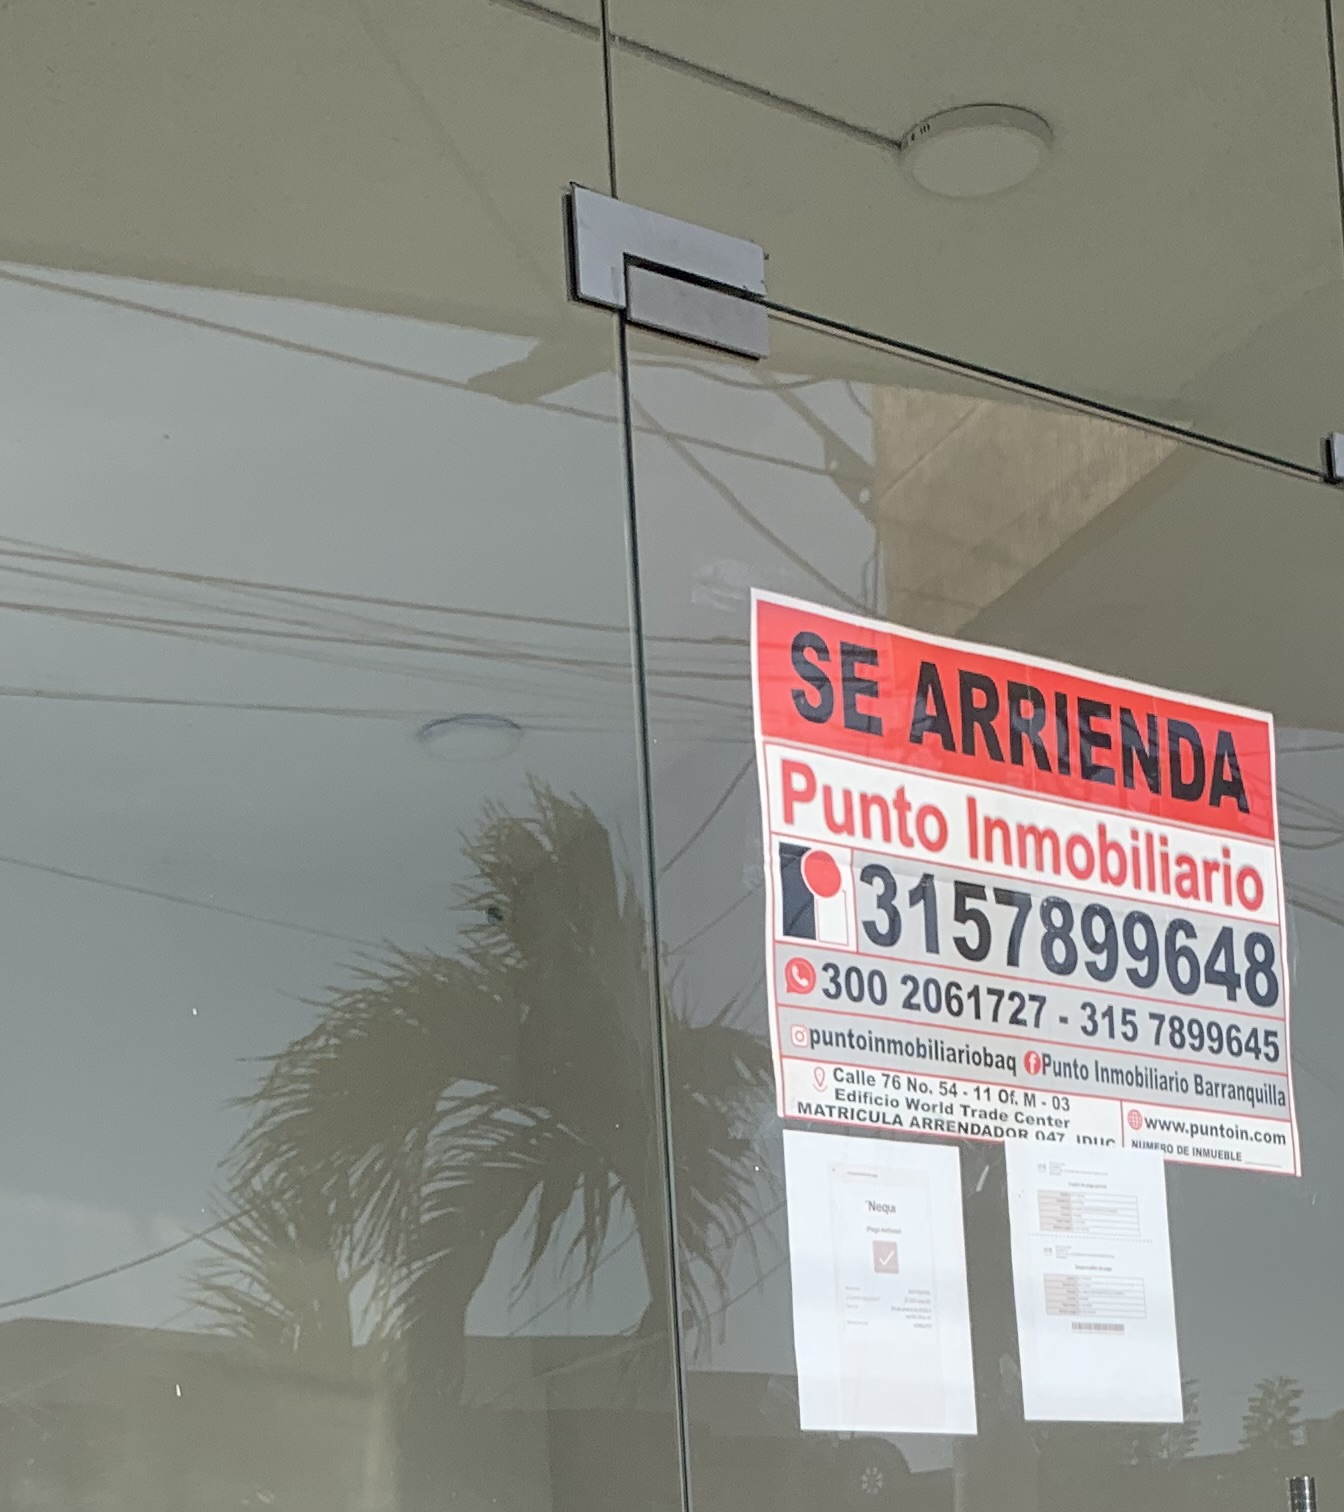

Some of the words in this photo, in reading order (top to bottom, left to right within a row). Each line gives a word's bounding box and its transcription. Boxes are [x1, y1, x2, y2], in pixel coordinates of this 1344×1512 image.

[790, 630, 883, 738] SE
[909, 661, 1250, 815] ARRIENDA
[781, 758, 947, 853] Punto
[967, 796, 1264, 912] Inmobiliario
[860, 862, 1281, 1007] 3157899648
[821, 962, 887, 1006] 300
[901, 974, 1047, 1029] 2061727
[1058, 1015, 1069, 1025] -
[1080, 1001, 1139, 1043] 315
[1148, 1012, 1280, 1063] 7899645
[809, 1027, 1017, 1077] puntoinmobiliariobaq
[833, 1067, 876, 1086] Calle
[881, 1073, 901, 1090] 76
[906, 1077, 933, 1095] No.
[939, 1082, 957, 1098] 54
[973, 1086, 991, 1102] 11
[998, 1089, 1019, 1105] Of.
[1023, 1092, 1036, 1107] M
[1052, 1096, 1070, 1112] 03
[1042, 1053, 1089, 1080] Punto
[1094, 1059, 1189, 1094] Inmobiliario
[1194, 1074, 1286, 1108] Barranquilla
[797, 1101, 904, 1127] MATRICULA
[909, 1116, 1028, 1140] ARRENDADOR
[1035, 1129, 1065, 1143] 047
[834, 1088, 899, 1108] Edificio
[905, 1096, 954, 1116] World
[959, 1104, 1008, 1122] Trade
[1014, 1111, 1070, 1129] Center
[1144, 1118, 1287, 1146] www.puntoin.com
[1176, 1143, 1189, 1155] DE
[1192, 1146, 1242, 1162] INMUEBLE
